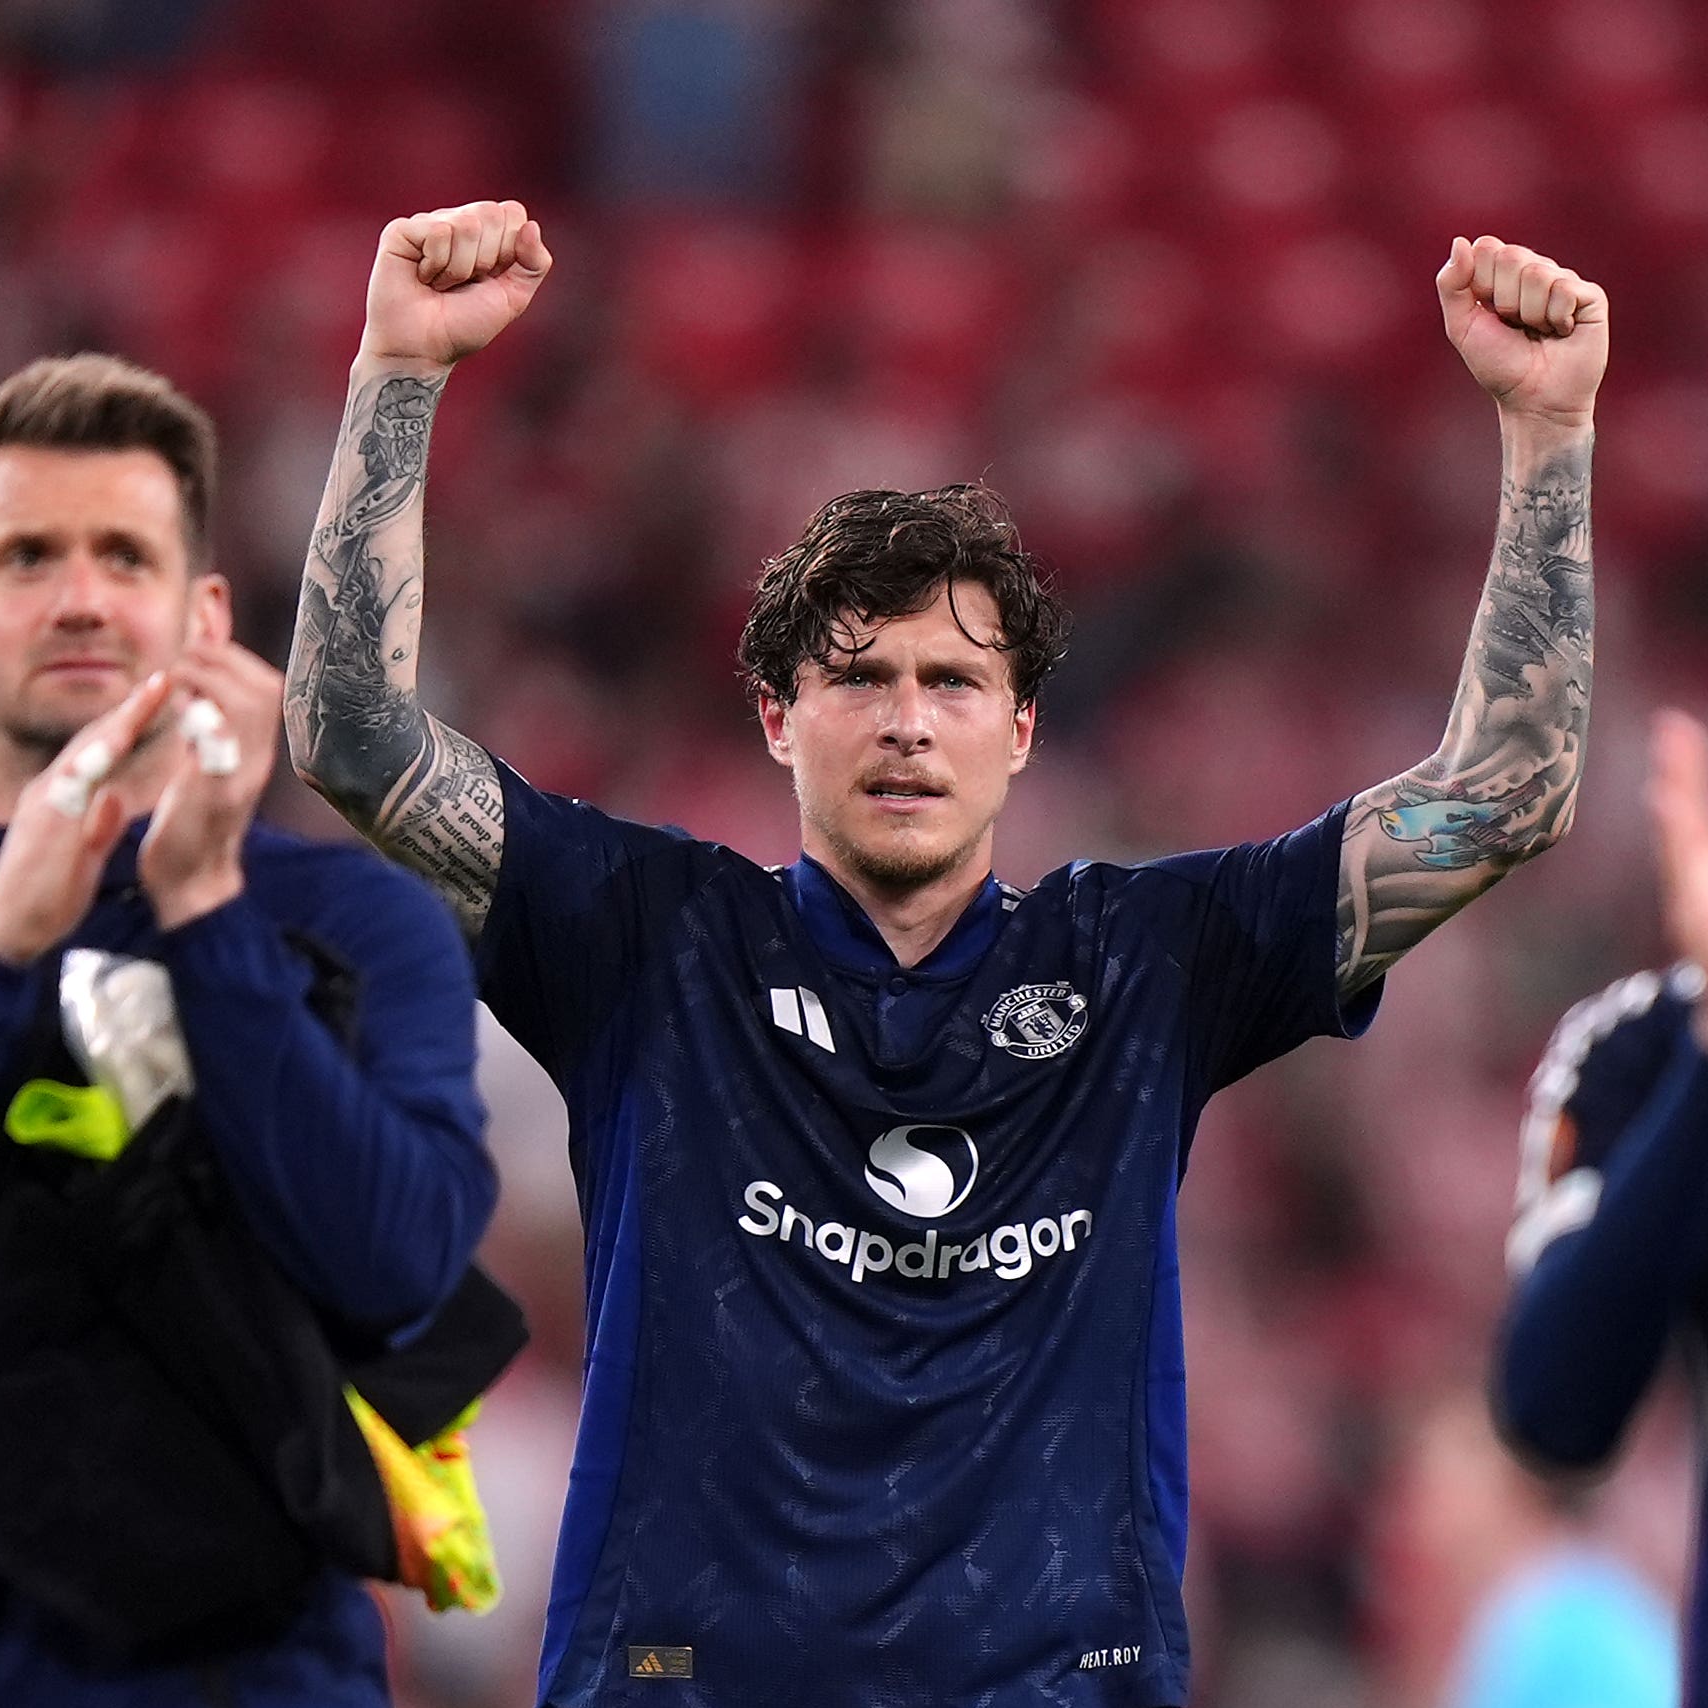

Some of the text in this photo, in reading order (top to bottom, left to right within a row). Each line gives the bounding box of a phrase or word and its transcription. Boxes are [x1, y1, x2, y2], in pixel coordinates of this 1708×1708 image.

[458, 811, 492, 842] group
[990, 987, 1067, 1028] MANCHESTER
[1027, 1024, 1081, 1056] UNITED
[738, 1180, 1093, 1283] Snapdragon
